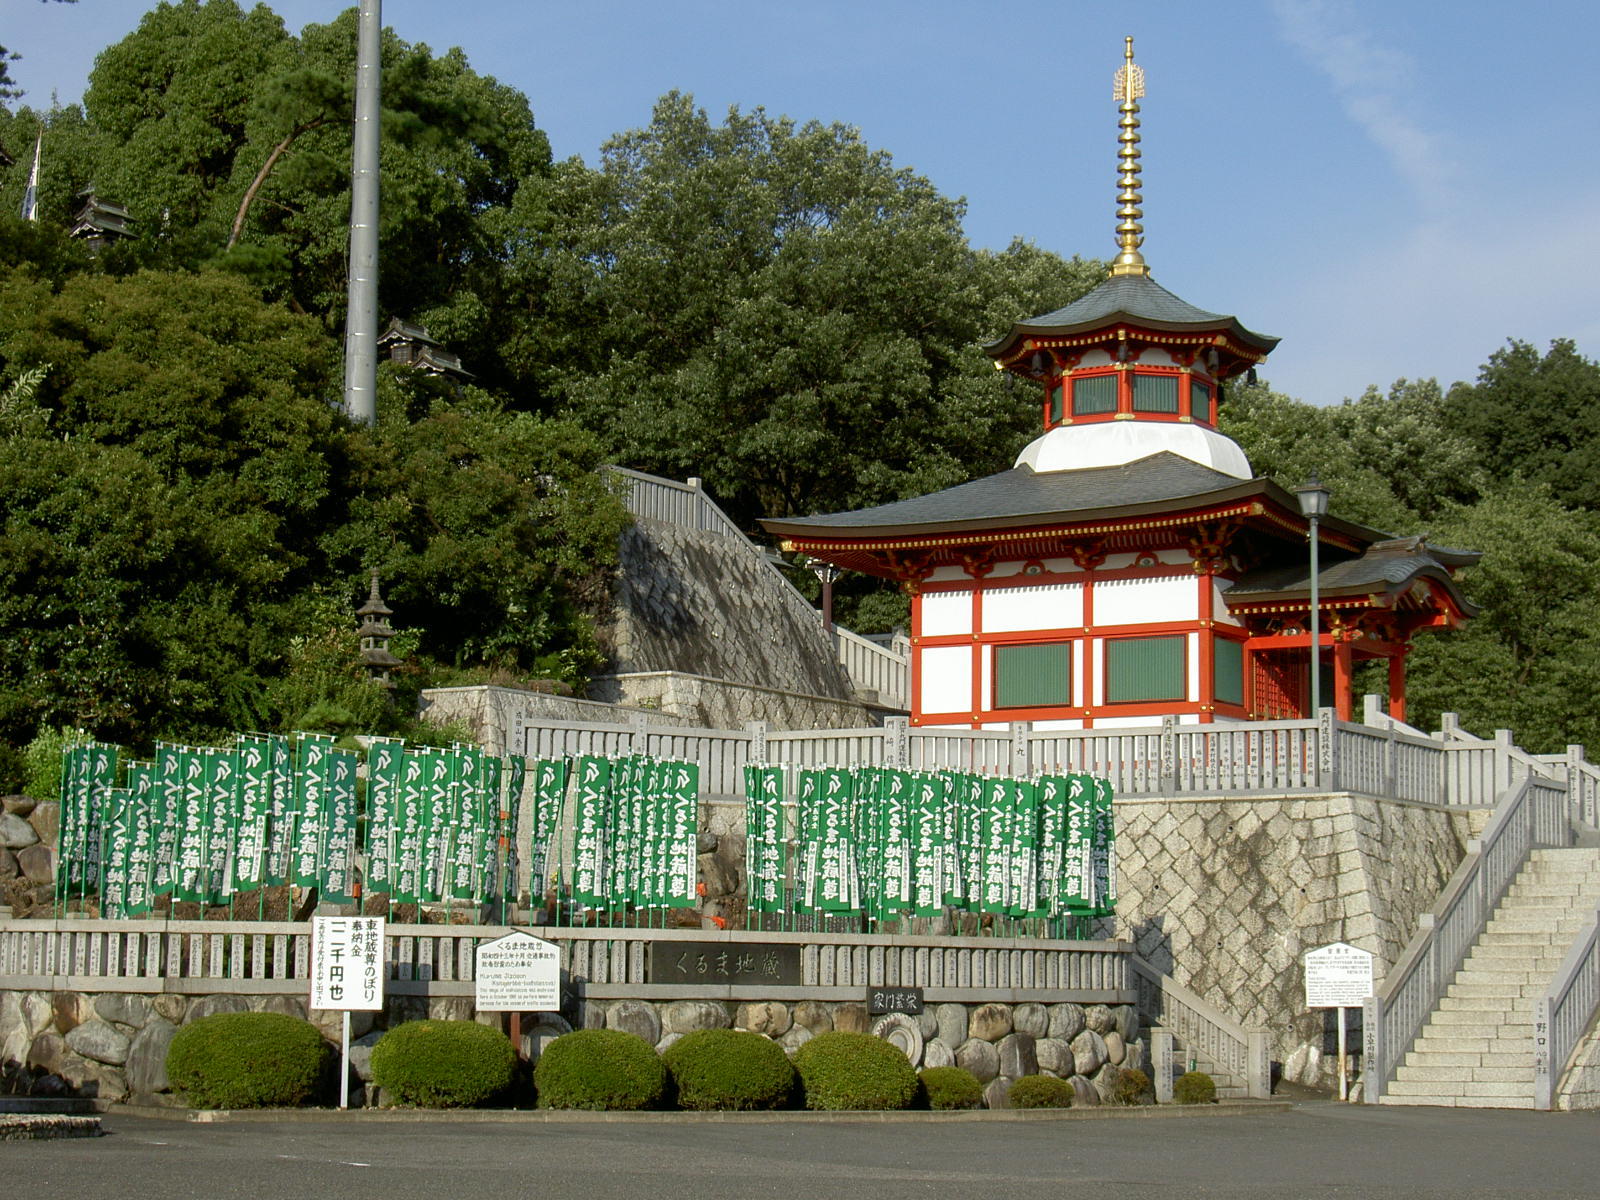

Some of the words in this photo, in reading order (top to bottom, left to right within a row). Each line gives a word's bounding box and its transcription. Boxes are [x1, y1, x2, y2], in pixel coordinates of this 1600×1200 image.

[352, 920, 362, 957] 奉納金
[364, 919, 378, 1002] 車地蔵尊のぼり
